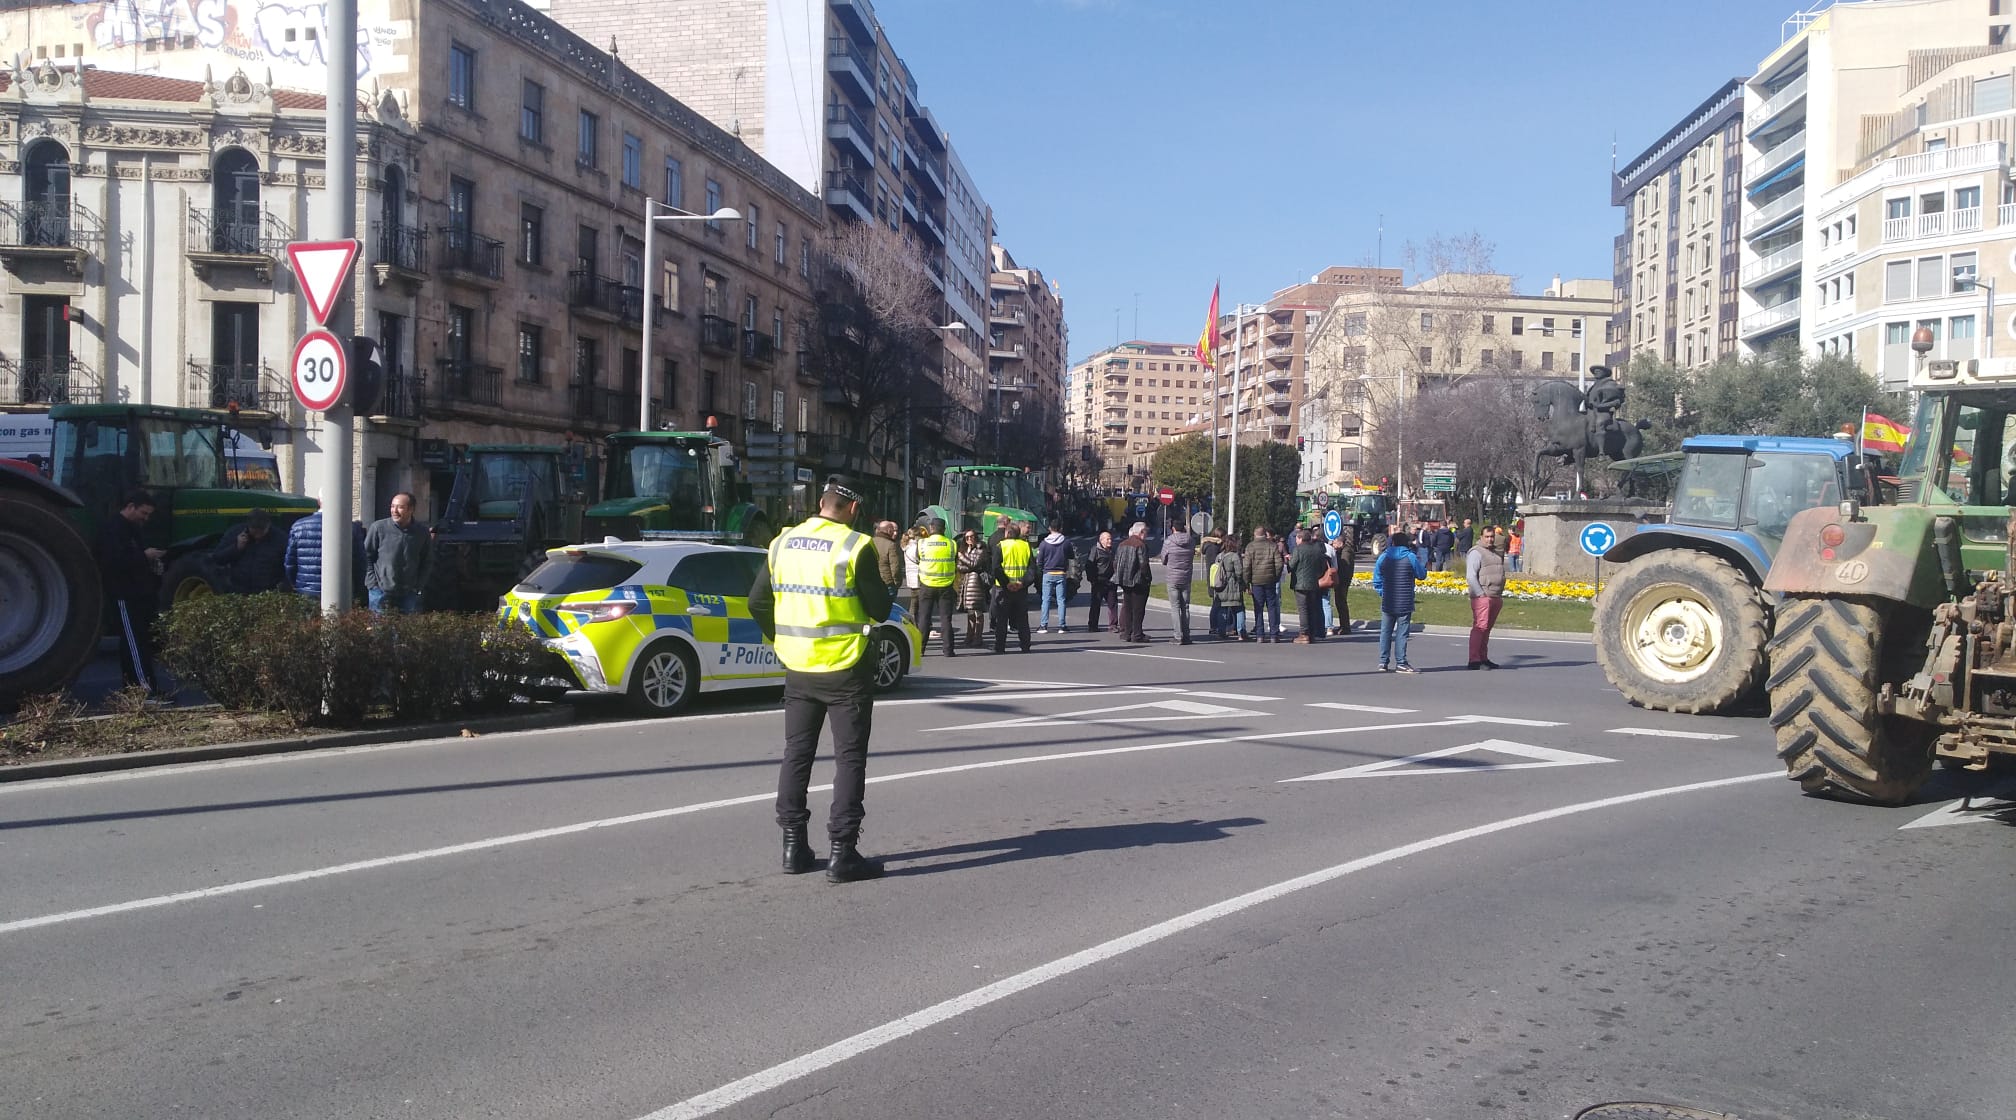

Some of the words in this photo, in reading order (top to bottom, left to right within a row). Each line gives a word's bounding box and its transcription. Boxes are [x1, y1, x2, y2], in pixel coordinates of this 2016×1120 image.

[303, 357, 334, 383] 30
[20, 428, 40, 438] gas
[786, 537, 829, 552] POLICÍA
[700, 594, 720, 605] 112
